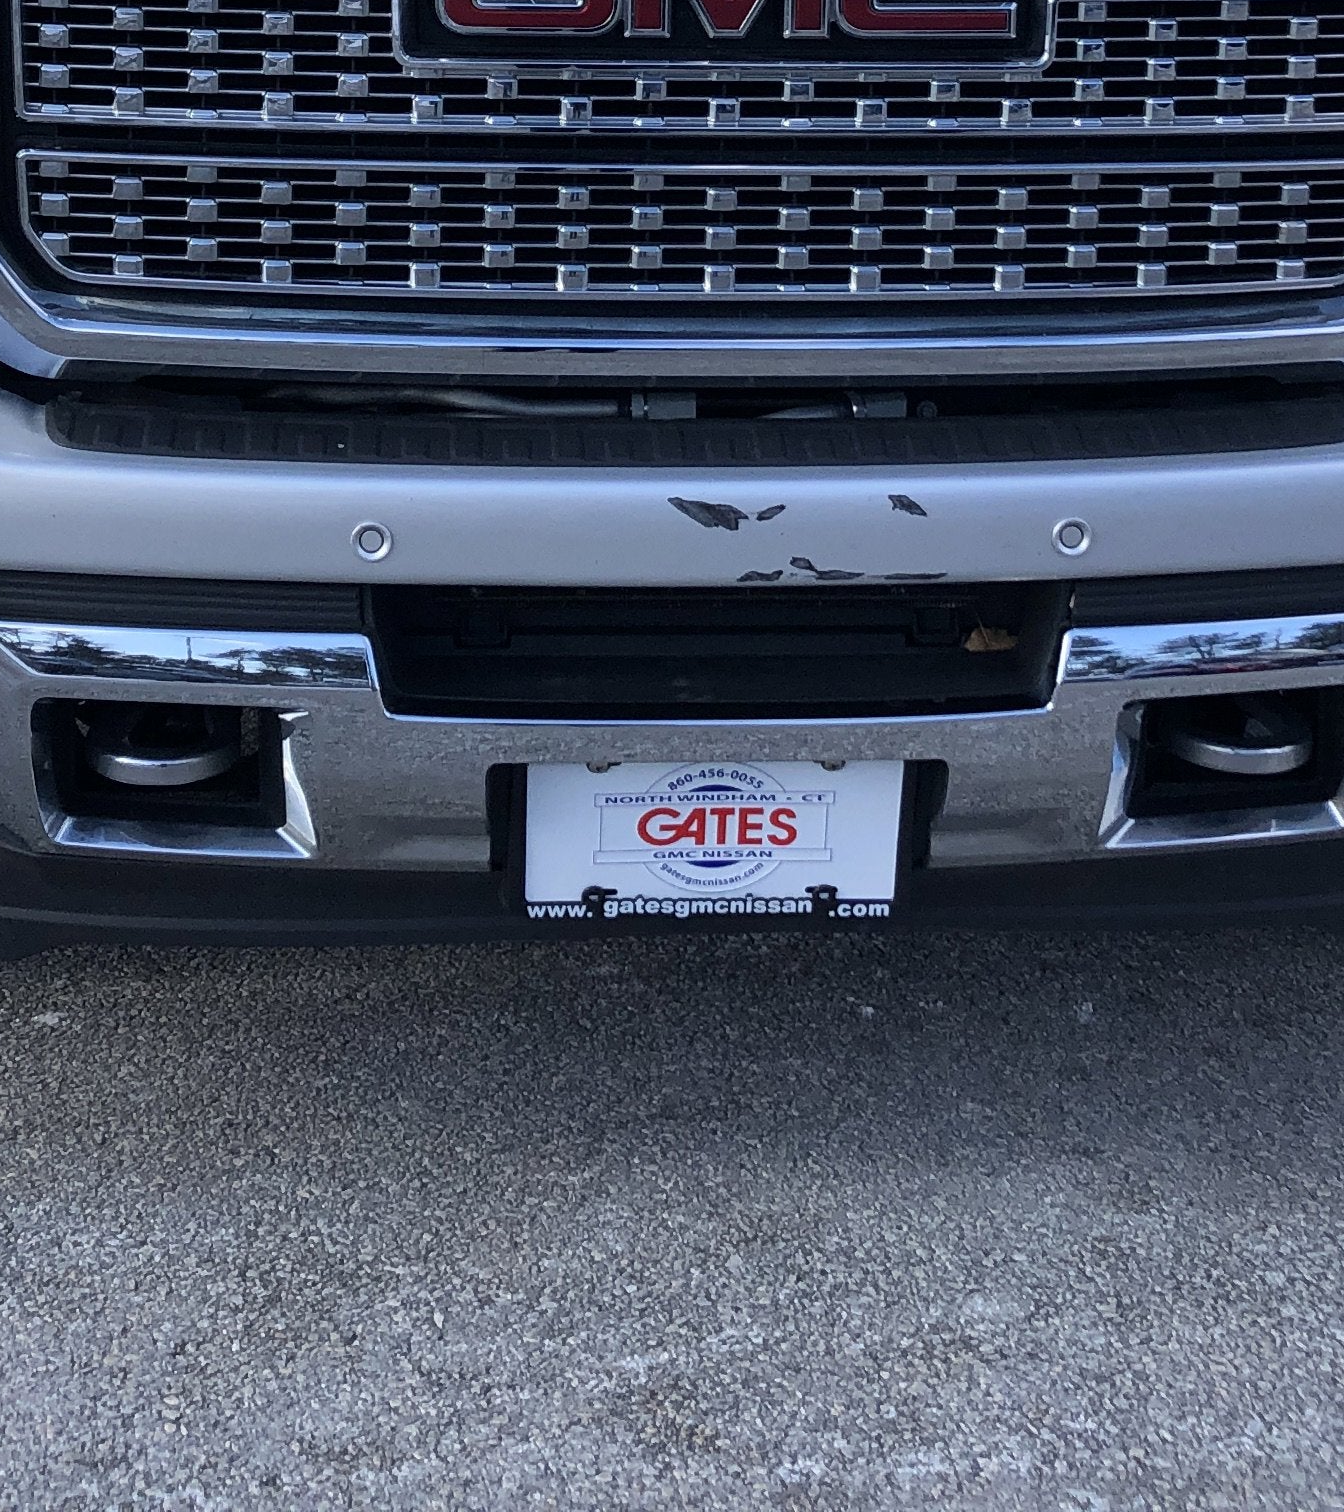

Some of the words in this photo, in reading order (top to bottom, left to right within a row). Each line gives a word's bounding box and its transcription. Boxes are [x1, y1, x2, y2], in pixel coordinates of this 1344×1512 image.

[667, 767, 764, 791] 860-456-0055
[604, 794, 672, 804] NORTH
[676, 793, 777, 802] WINDHAM
[801, 794, 827, 802] CT
[636, 807, 798, 846] GATES
[652, 851, 697, 859] GMC
[702, 850, 773, 859] NISSAN
[659, 862, 764, 887] gatesgmcnissan.com
